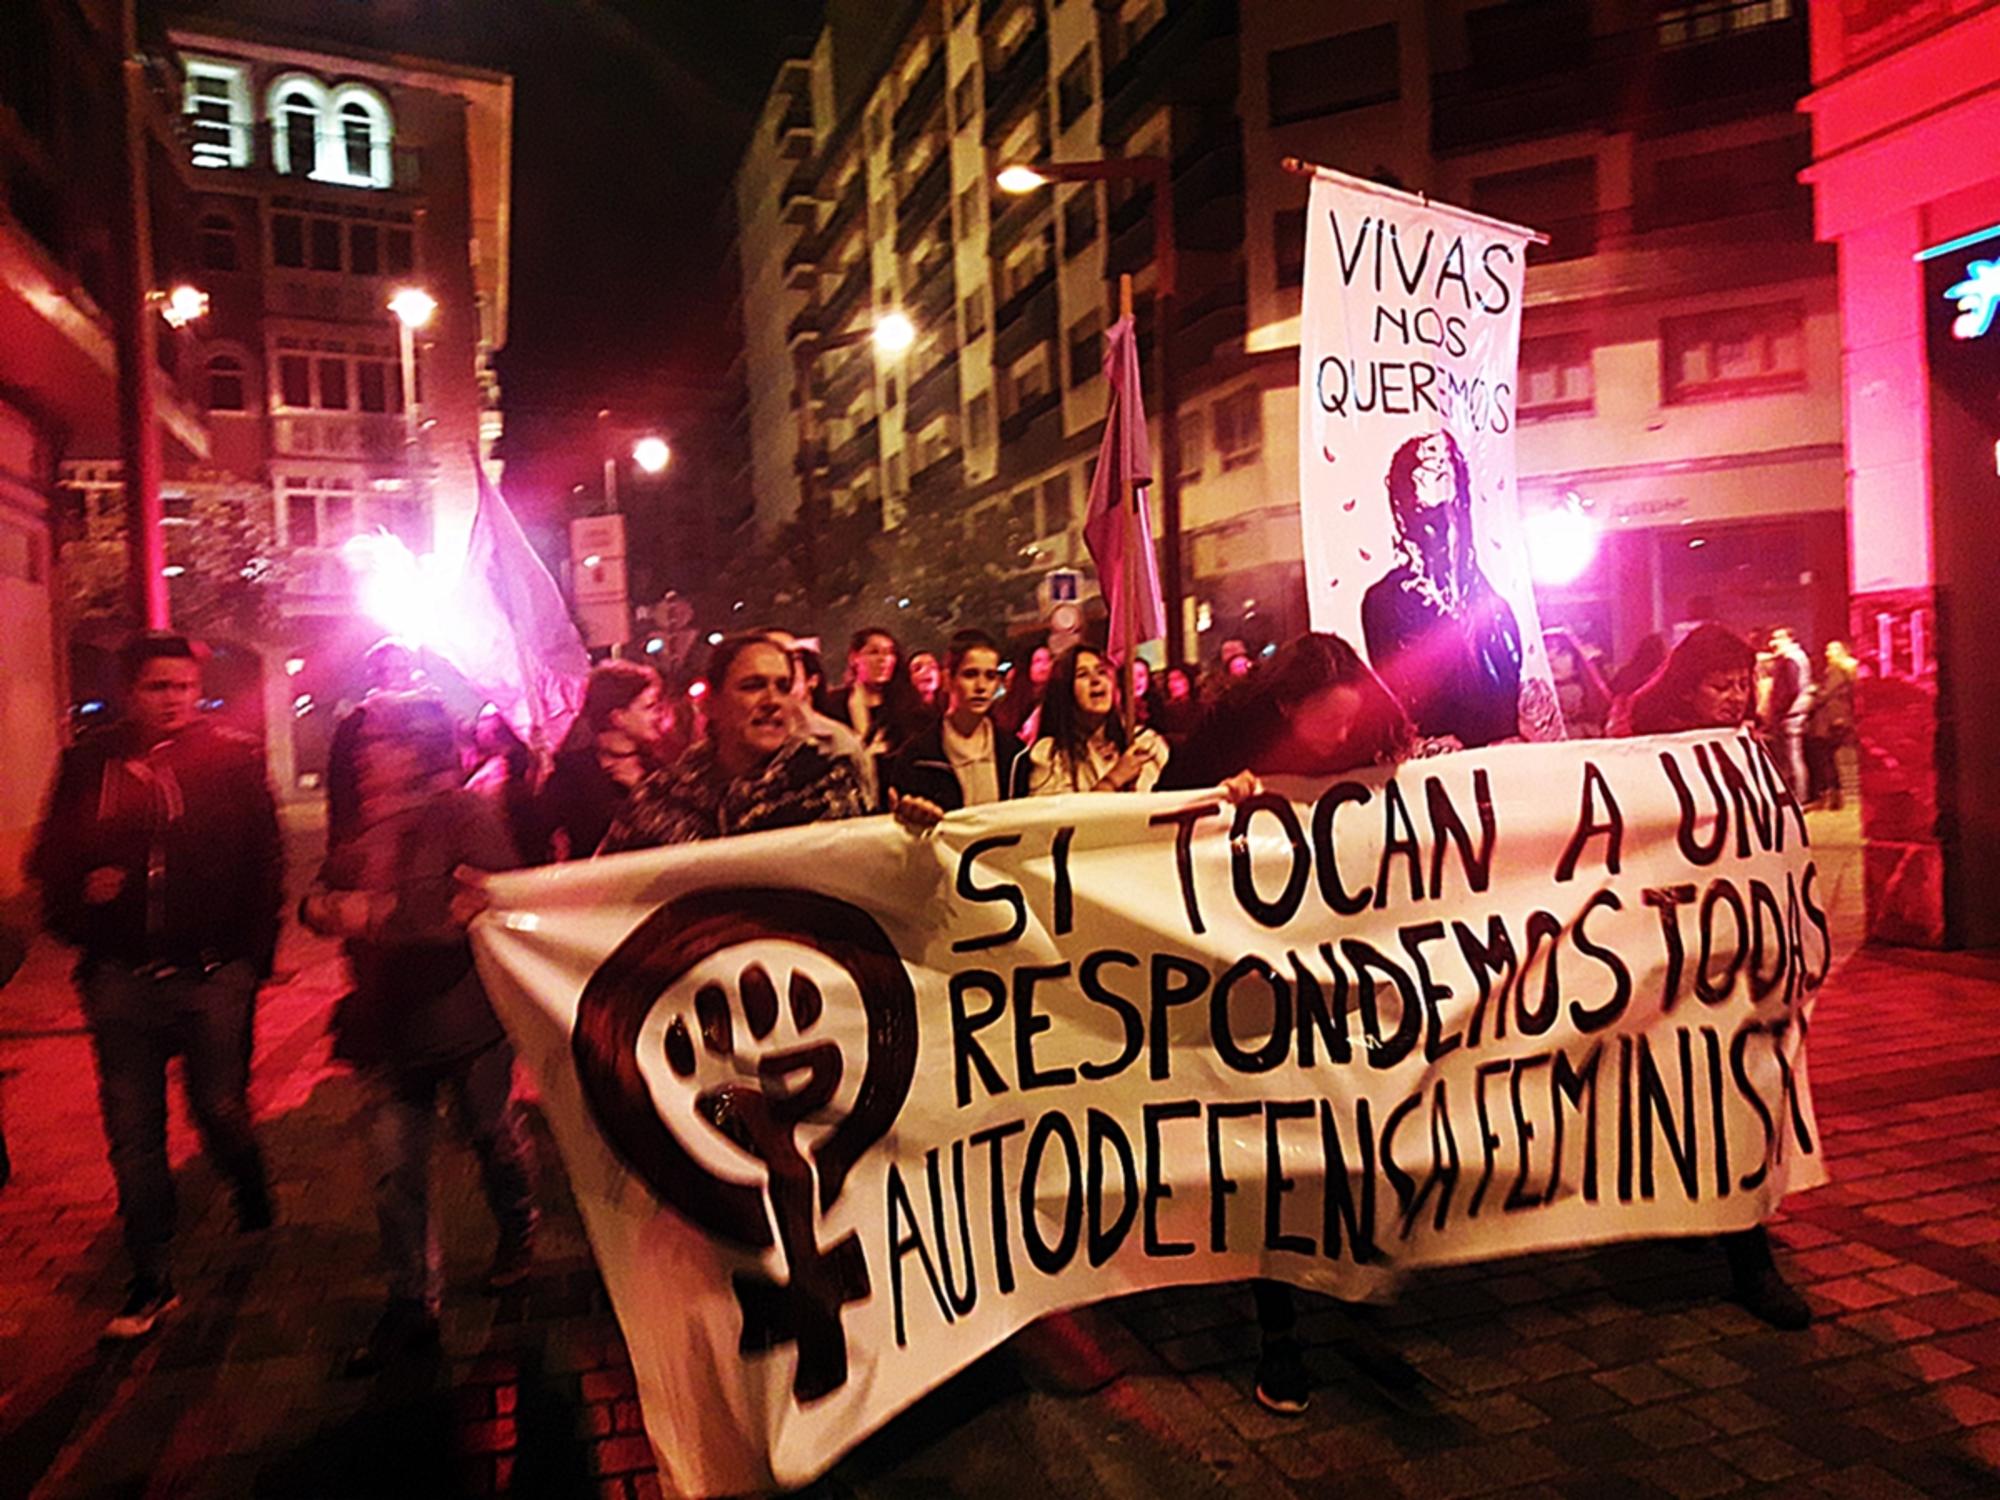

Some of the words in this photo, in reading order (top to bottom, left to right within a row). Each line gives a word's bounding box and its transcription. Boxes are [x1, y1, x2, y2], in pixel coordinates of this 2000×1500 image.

[1329, 210, 1515, 315] VIVAS
[1374, 305, 1467, 358] NOS
[952, 826, 1075, 953] SI
[1149, 768, 1496, 934] TOCAN
[1554, 761, 1623, 882] A
[1659, 735, 1810, 867] UNA
[948, 888, 1633, 1108] RESPONDEMOS
[1641, 861, 1832, 1014] TODAS
